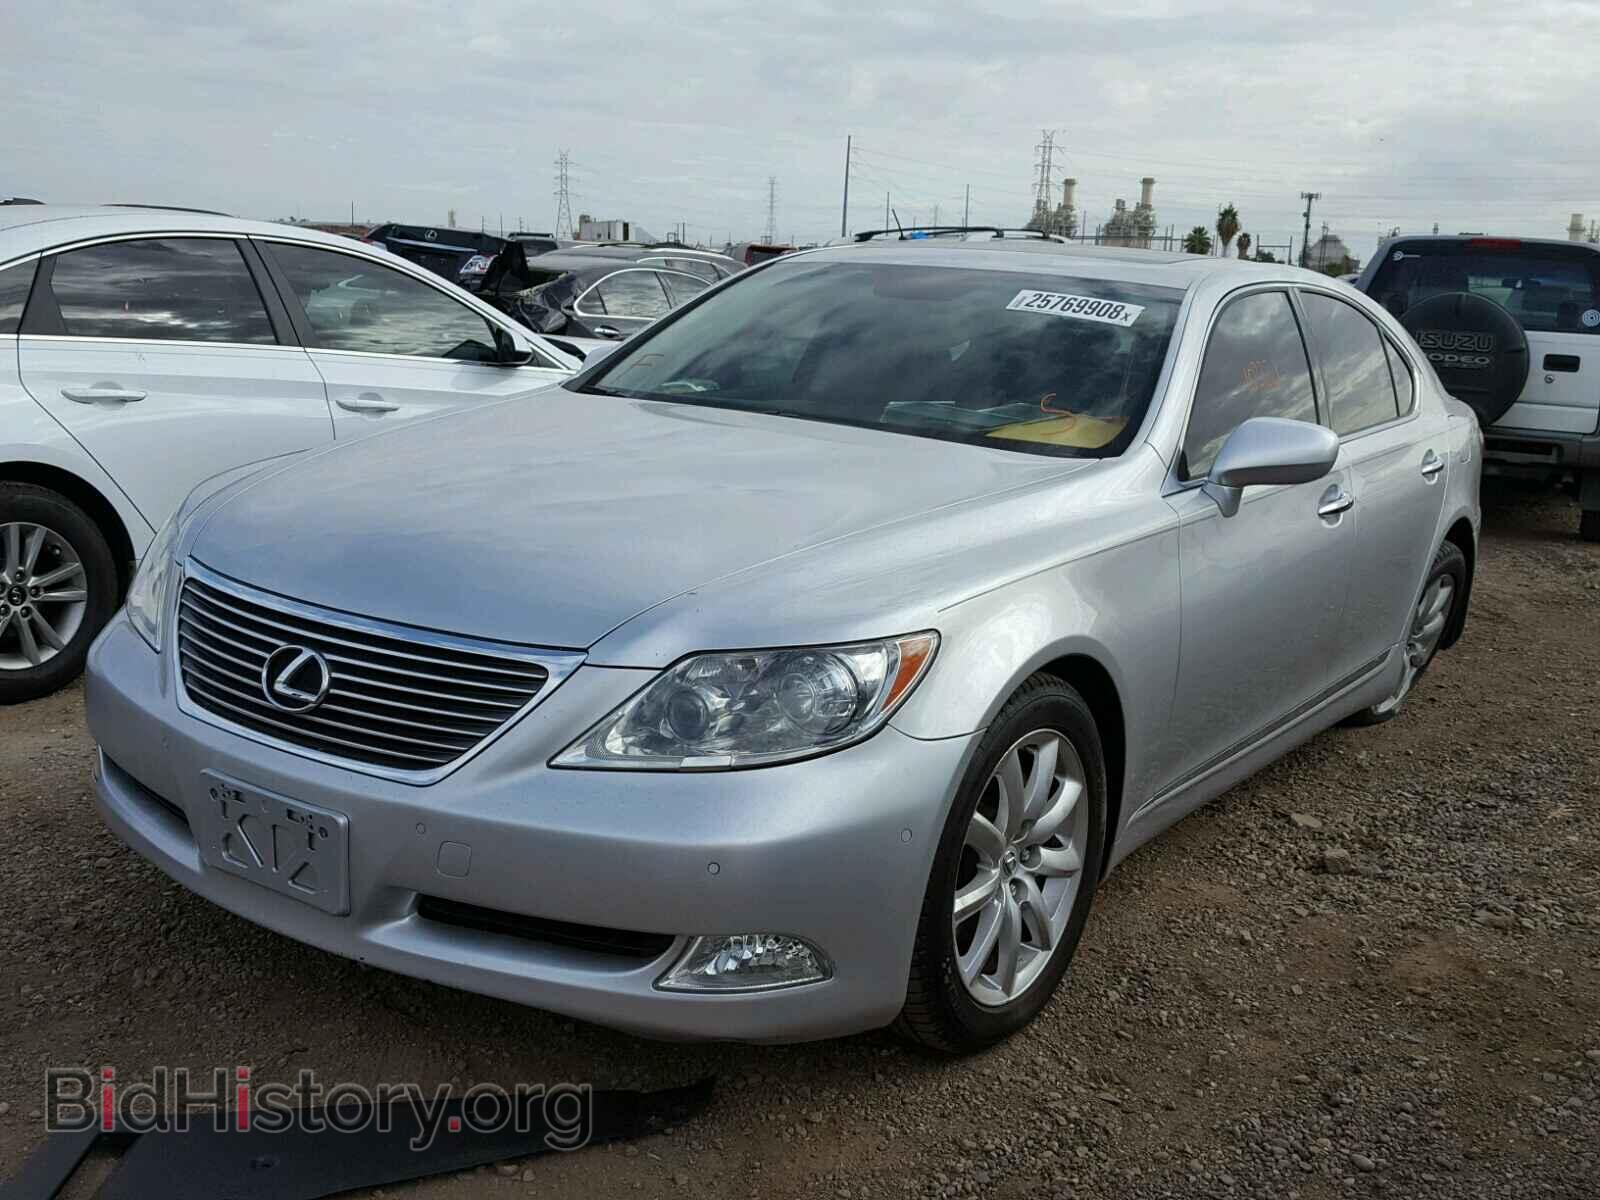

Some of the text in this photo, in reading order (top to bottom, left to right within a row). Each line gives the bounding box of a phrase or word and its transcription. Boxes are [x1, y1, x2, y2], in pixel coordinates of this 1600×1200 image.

[1024, 293, 1126, 319] 25769908
[1416, 330, 1493, 351] ISUZU
[1424, 353, 1490, 365] ODEO
